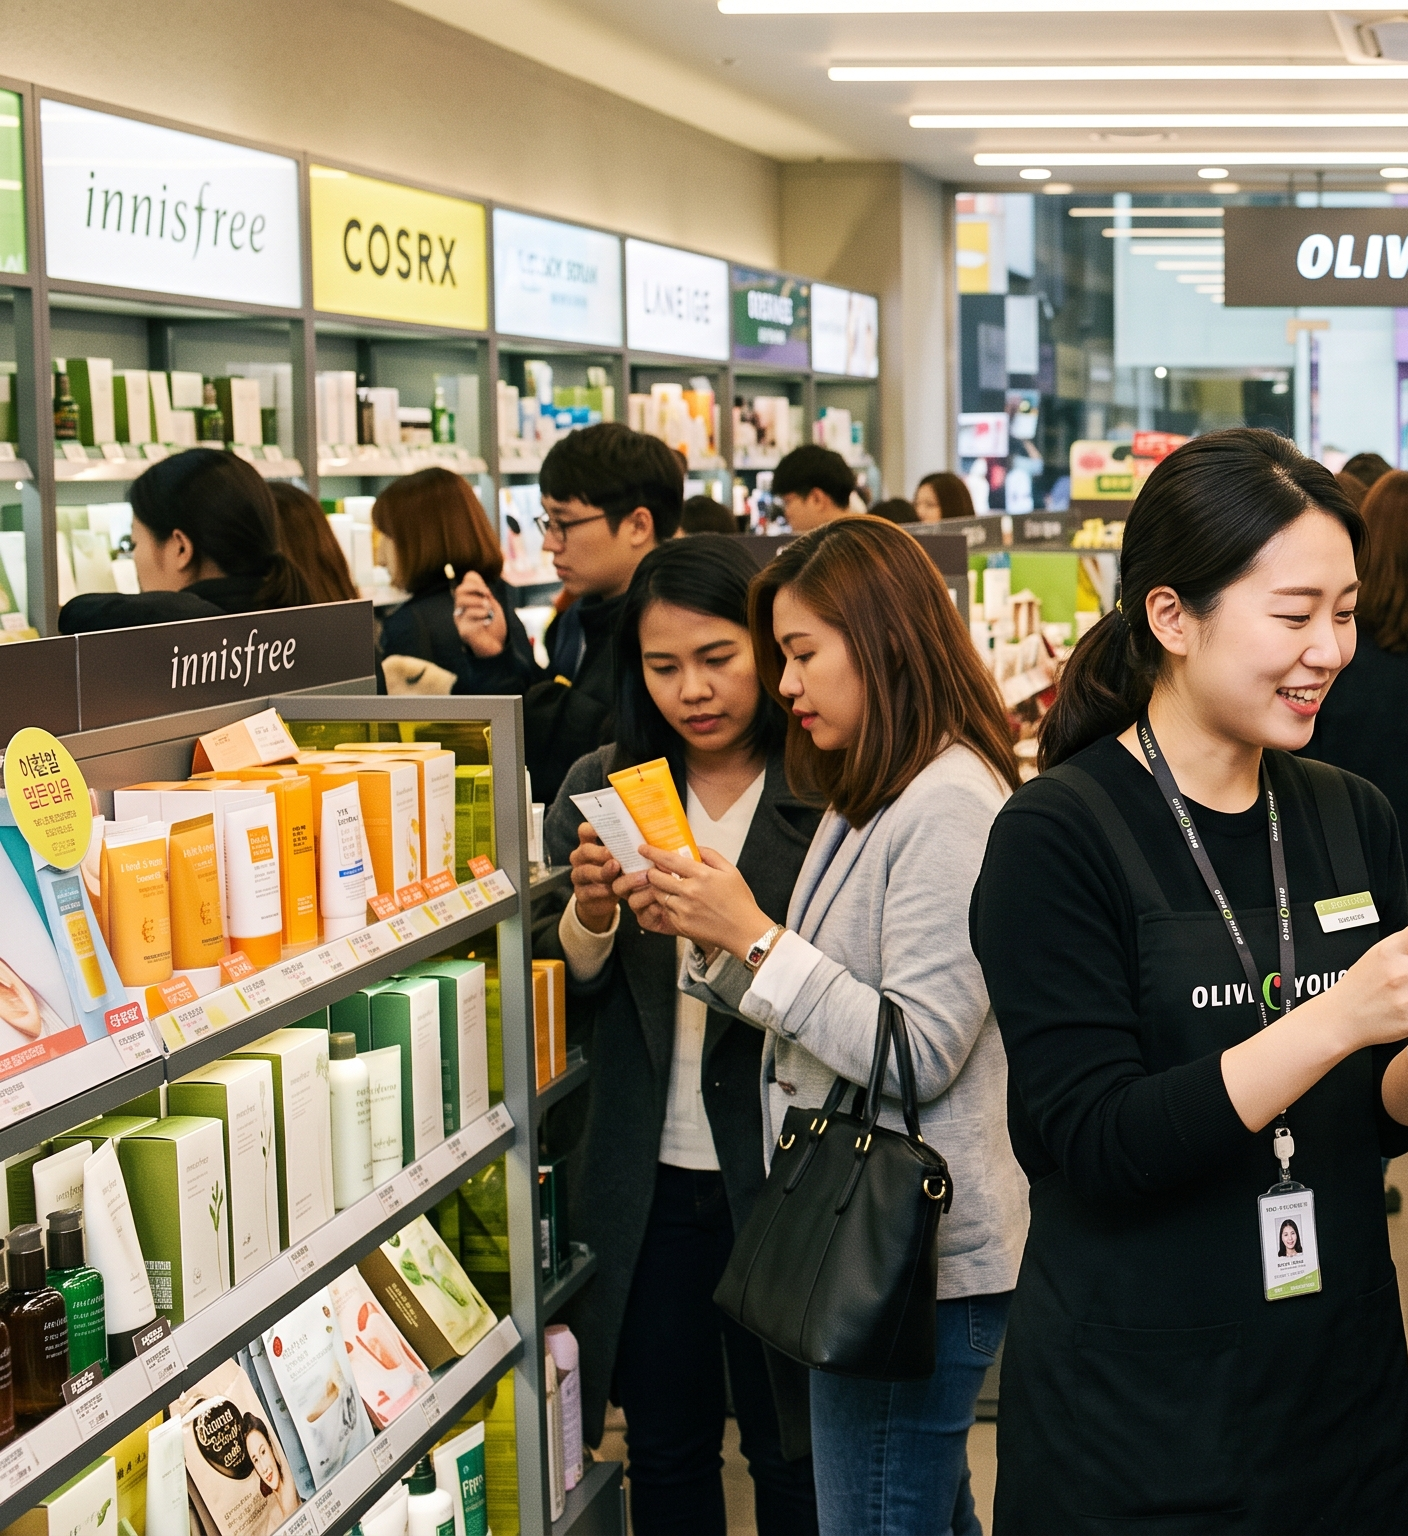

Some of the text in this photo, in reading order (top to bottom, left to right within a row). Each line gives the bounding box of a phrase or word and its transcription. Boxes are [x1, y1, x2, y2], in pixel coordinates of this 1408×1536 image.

[86, 172, 267, 260] innisfree
[343, 218, 457, 287] COSRX
[642, 280, 711, 325] LANEIGE
[170, 628, 297, 689] innisfree
